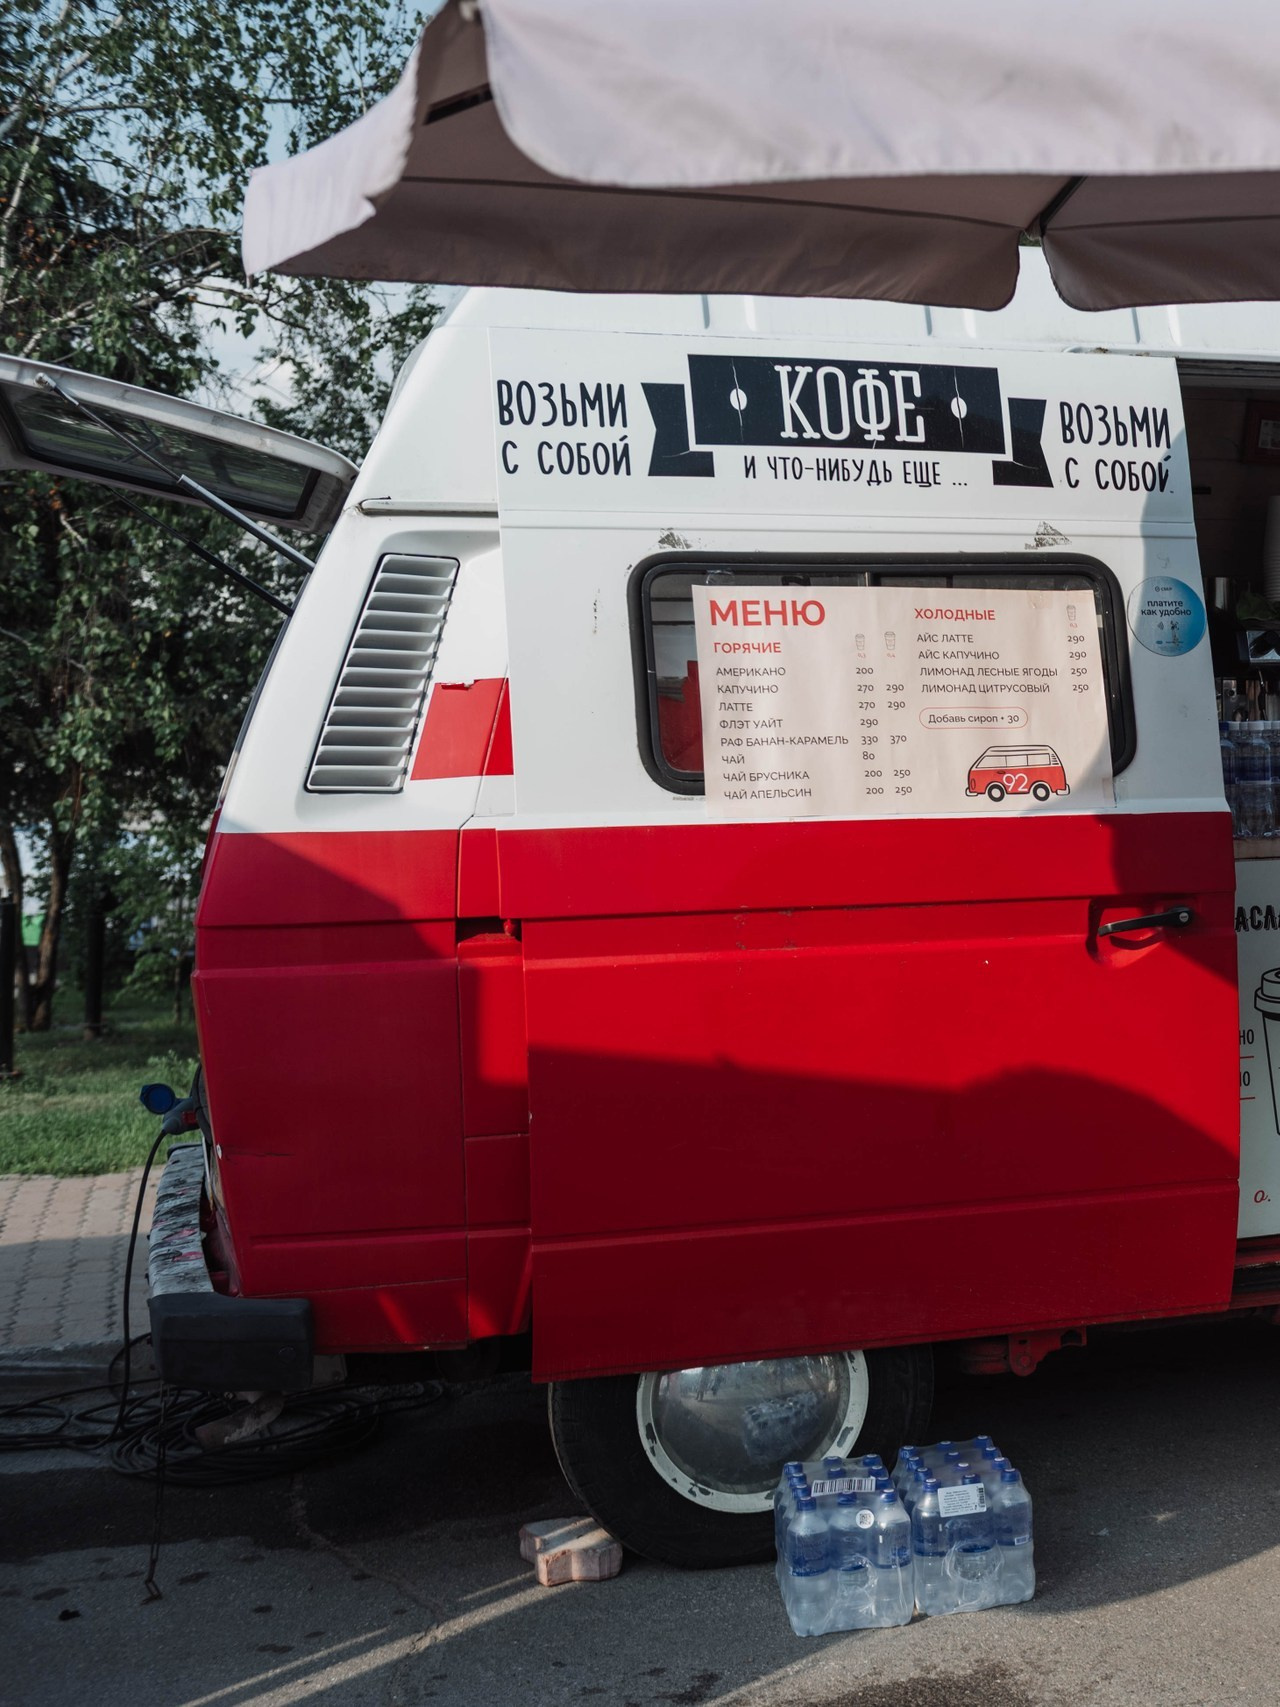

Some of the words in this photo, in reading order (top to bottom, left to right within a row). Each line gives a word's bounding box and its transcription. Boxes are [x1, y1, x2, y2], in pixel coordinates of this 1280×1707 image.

[497, 380, 627, 428] ВОЗЬМИ
[775, 365, 926, 443] КОФЕ
[1060, 402, 1171, 449] ВОЗЬМИ
[502, 440, 518, 474] С
[538, 435, 631, 476] СОБОЙ
[744, 455, 756, 479] И
[767, 455, 893, 487] ЧТО-НИБУДЬ
[903, 461, 941, 488] ЕЩЕ
[1065, 458, 1079, 488] С
[1095, 455, 1174, 494] СОБОЙ
[709, 600, 826, 626] МЕНЮ
[914, 608, 996, 621] ХОЛОДНЫЕ
[1159, 607, 1192, 617] удобно
[917, 633, 938, 643] АЙС
[941, 634, 974, 643] ЛАТТЕ
[1067, 635, 1085, 645] 290
[714, 642, 782, 654] ГОРЯЧИЕ
[918, 650, 940, 660] АЙС
[942, 651, 1000, 660] КАПУЧИНО
[1069, 651, 1087, 661] 290
[716, 667, 786, 677] АМЕРИКАНО
[856, 667, 874, 675] 200
[920, 667, 975, 677] ЛИМОНАД
[977, 667, 1020, 677] ЛЕСНЫЕ
[1022, 667, 1058, 677] ЯГОДЫ
[1071, 667, 1087, 676] 250
[717, 684, 778, 694] КАПУЧИНО
[857, 684, 874, 693] 270
[886, 684, 904, 692] 290
[921, 684, 977, 694] ЛИМОНАД
[978, 683, 1050, 694] ЦИТРУСОВЫЙ
[1072, 684, 1089, 693] 250
[718, 702, 753, 712] ЛАТТЕ
[859, 702, 876, 710] 270
[887, 701, 906, 710] 290
[719, 719, 750, 729] ФЛЭТ
[753, 718, 783, 728] УАЙТ
[860, 719, 878, 727] 290
[928, 714, 966, 724] Добавь
[968, 715, 998, 724] сироп
[1007, 715, 1019, 724] 30
[720, 738, 743, 747] РАФ
[746, 735, 849, 747] БАНАН-КАРАМЕЛЬ
[861, 735, 878, 745] 330
[890, 735, 907, 744] 370
[722, 754, 745, 764] ЧАЙ
[862, 752, 875, 760] 80
[723, 771, 747, 782] ЧАЙ
[750, 771, 809, 781] БРУСНИКА
[865, 769, 882, 778] 200
[894, 769, 911, 777] 250
[1003, 773, 1028, 792] 92
[724, 788, 748, 799] ЧАЙ
[750, 788, 812, 799] АПЕЛЬСИН
[866, 787, 884, 795] 200
[895, 786, 912, 795] 250
